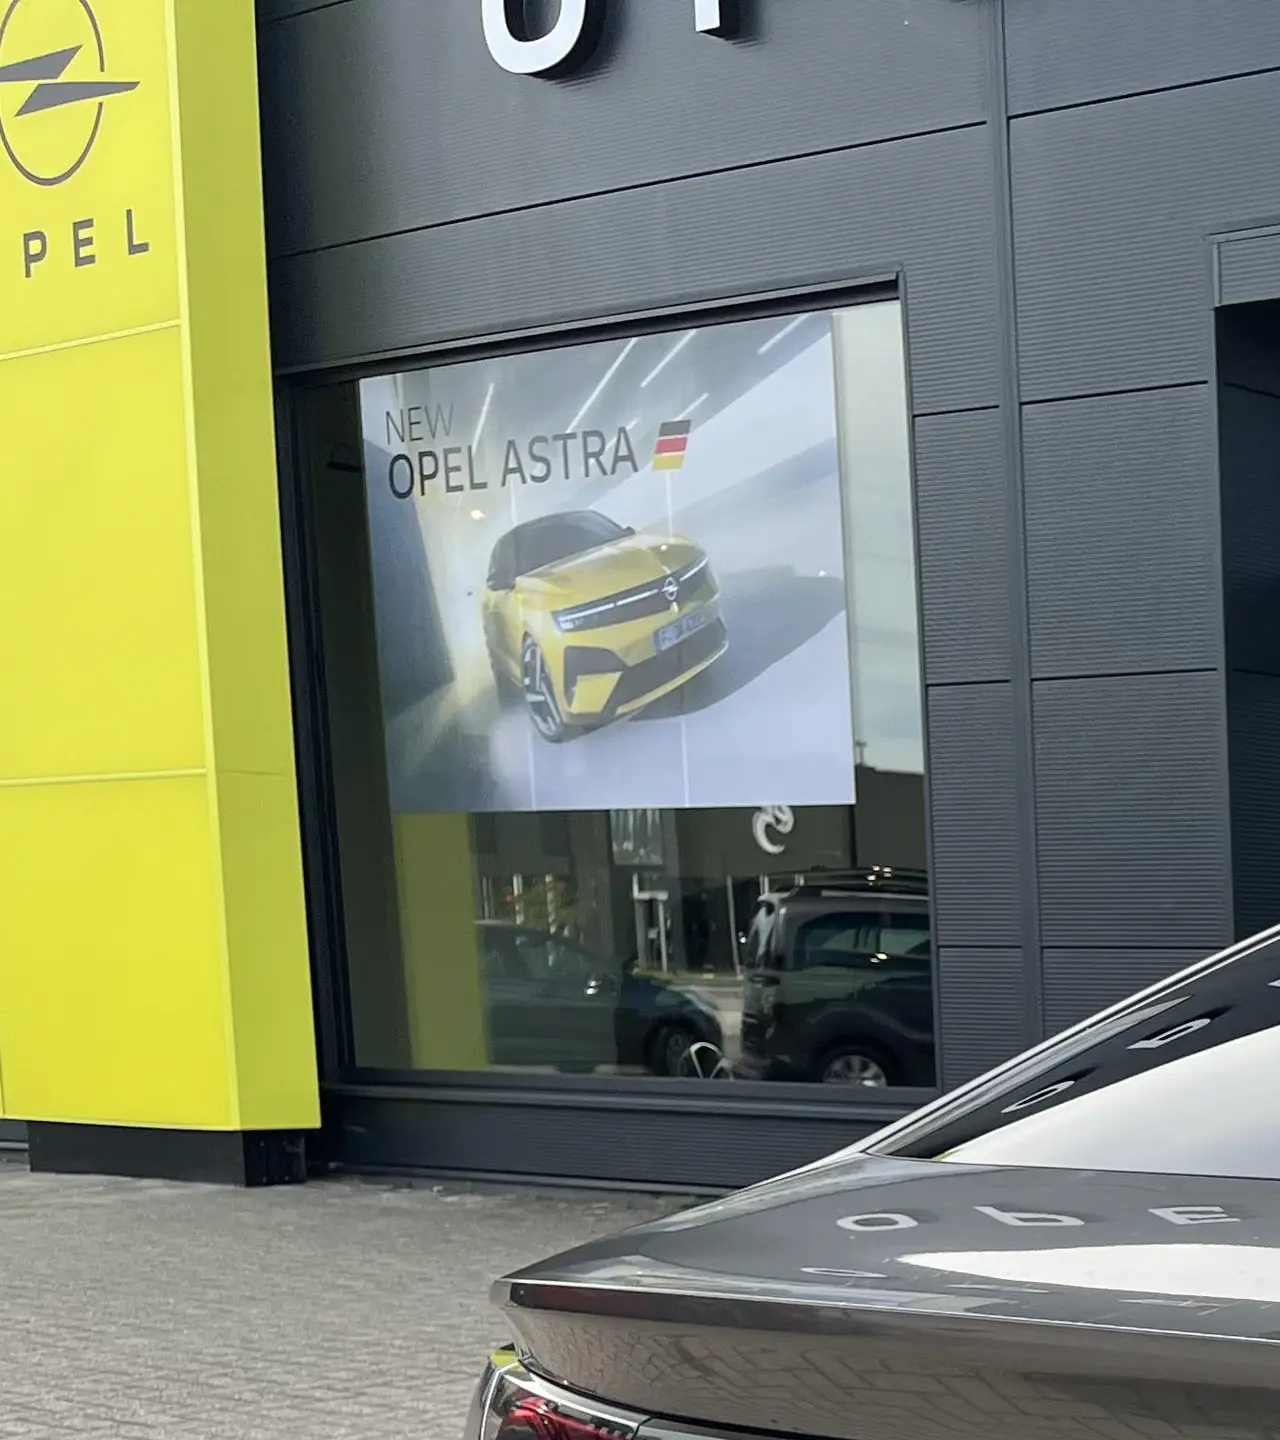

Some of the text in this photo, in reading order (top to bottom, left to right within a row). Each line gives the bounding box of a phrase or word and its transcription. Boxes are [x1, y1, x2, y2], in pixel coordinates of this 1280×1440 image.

[384, 402, 455, 446] NEW
[388, 426, 639, 500] OPEL ASTRA
